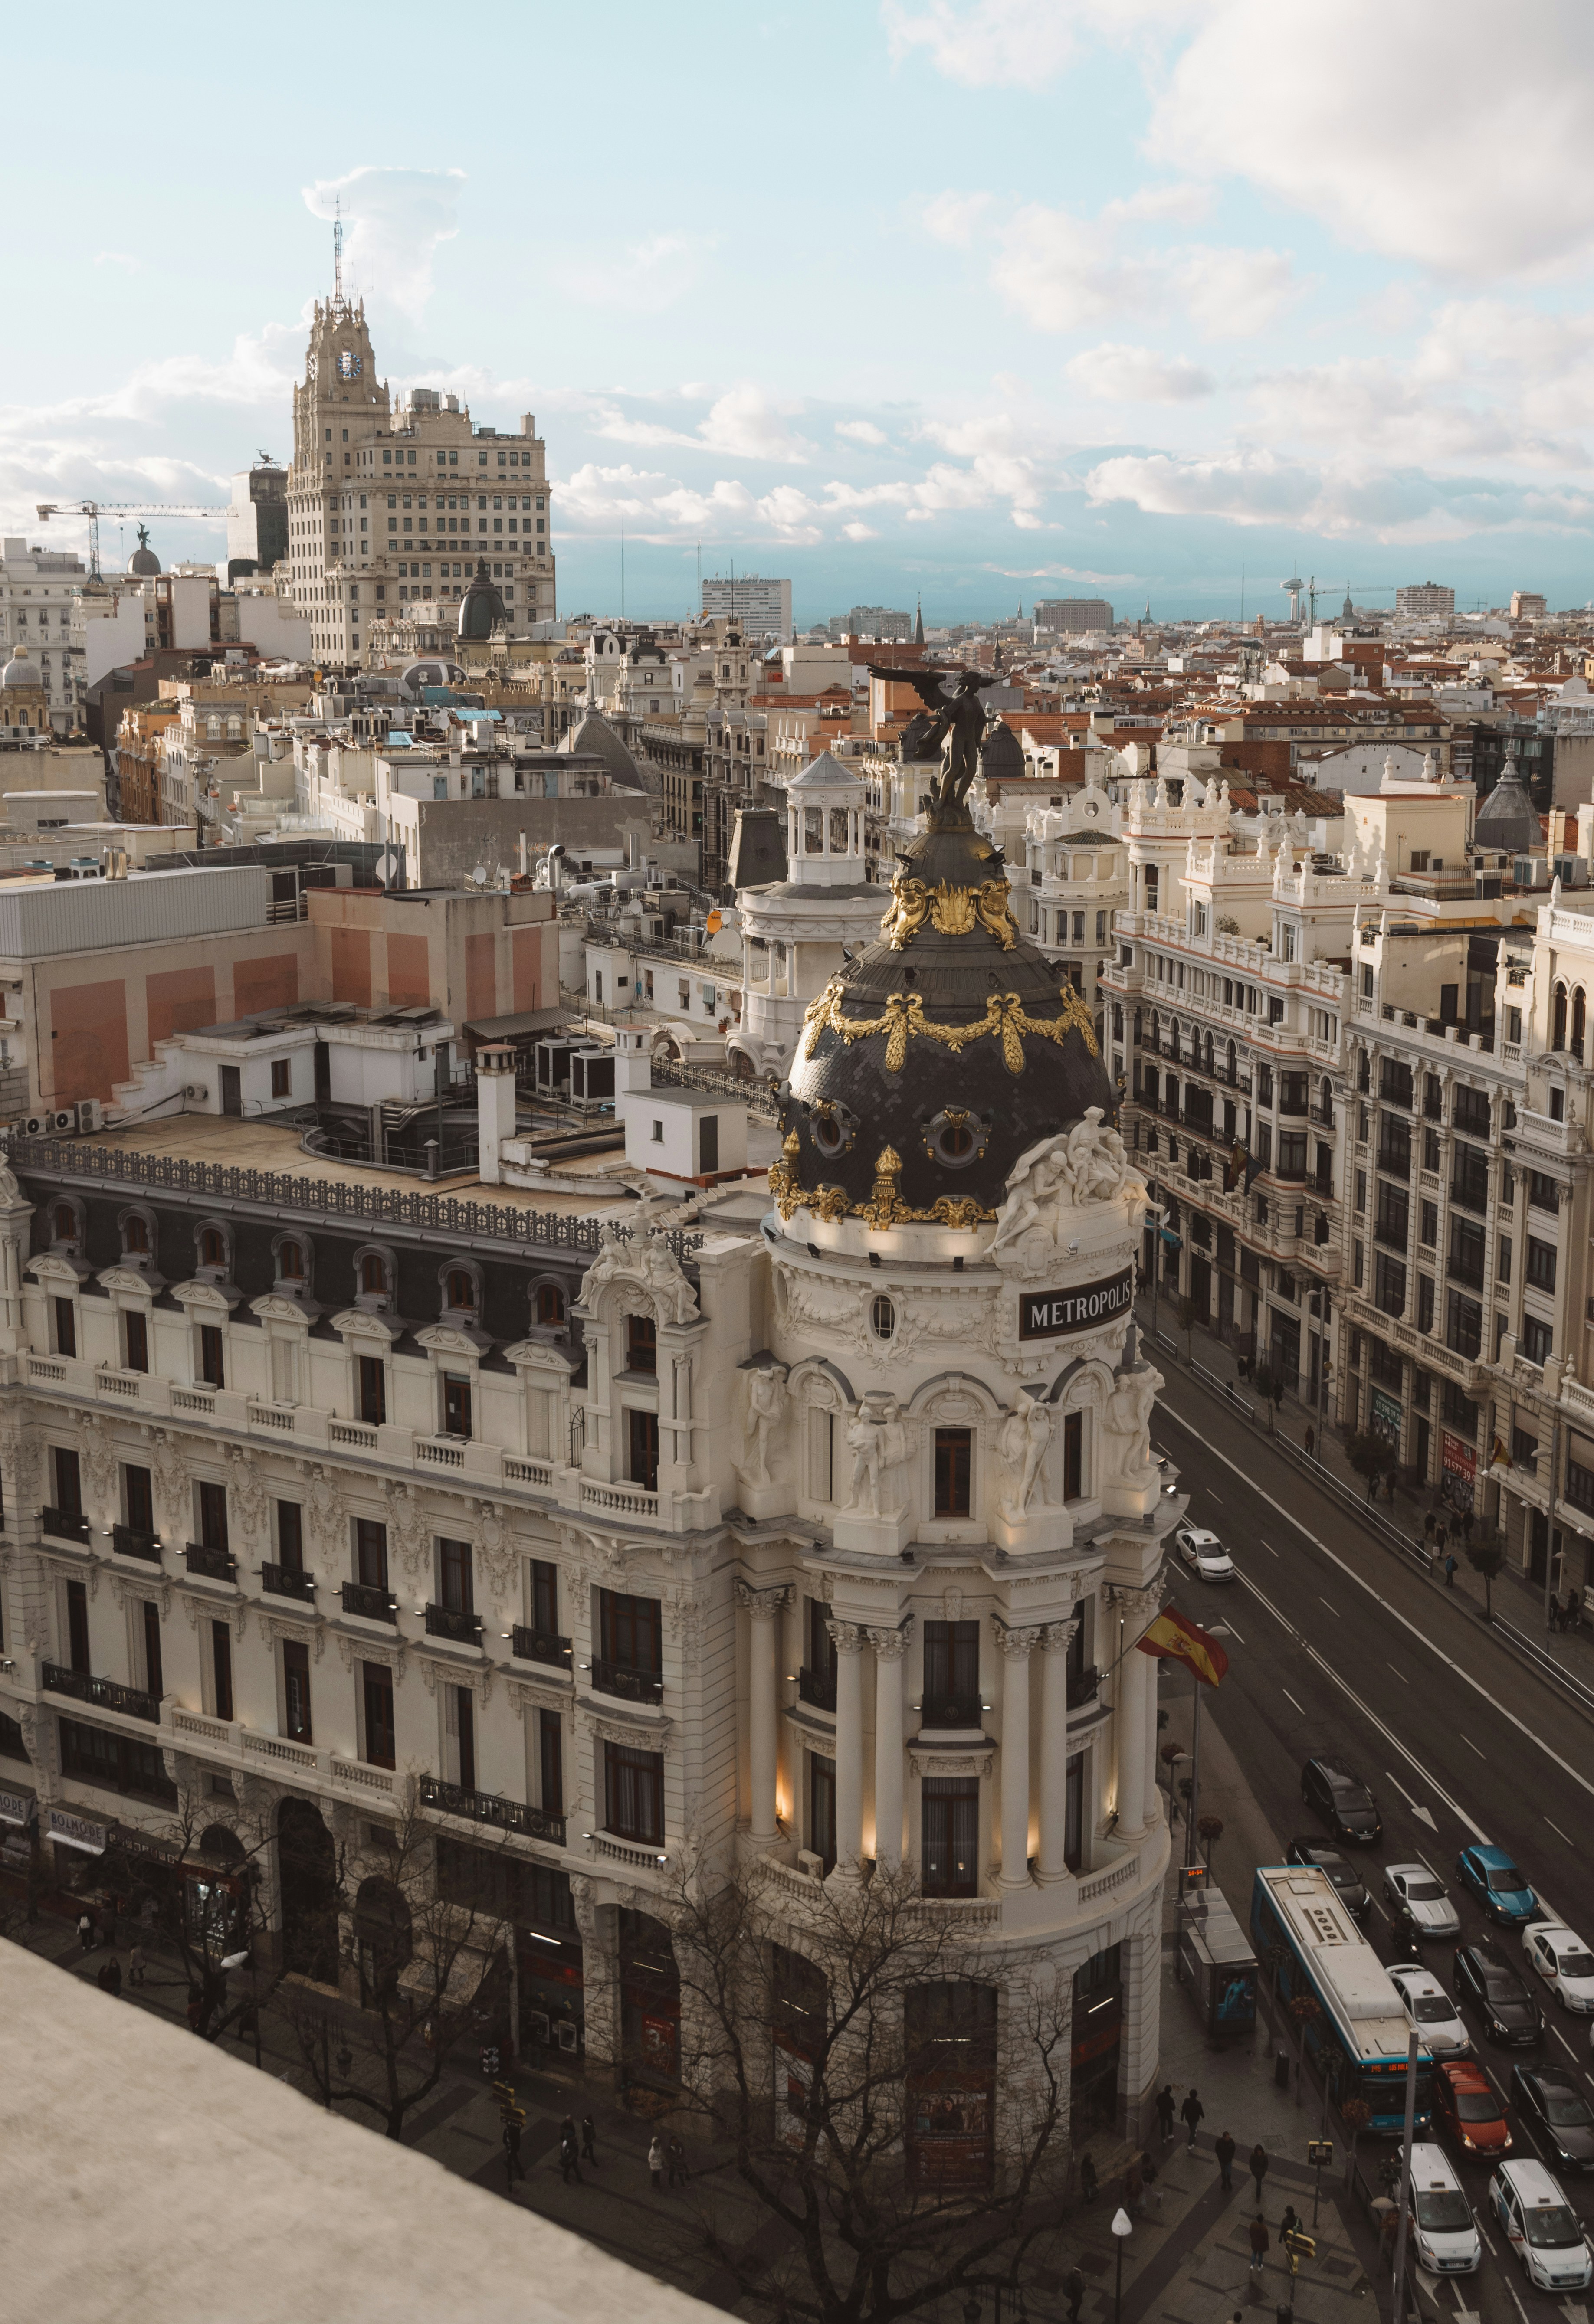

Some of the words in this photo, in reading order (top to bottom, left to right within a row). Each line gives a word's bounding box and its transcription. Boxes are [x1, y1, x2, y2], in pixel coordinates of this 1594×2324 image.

[1031, 1280, 1130, 1328] METROPOLIS
[1376, 1400, 1381, 1409] 91
[1391, 1409, 1396, 1418] 19
[1444, 1456, 1450, 1468] 91
[1452, 1462, 1462, 1475] 577
[1463, 1469, 1470, 1481] 39
[52, 1813, 101, 1839] BOLMODE
